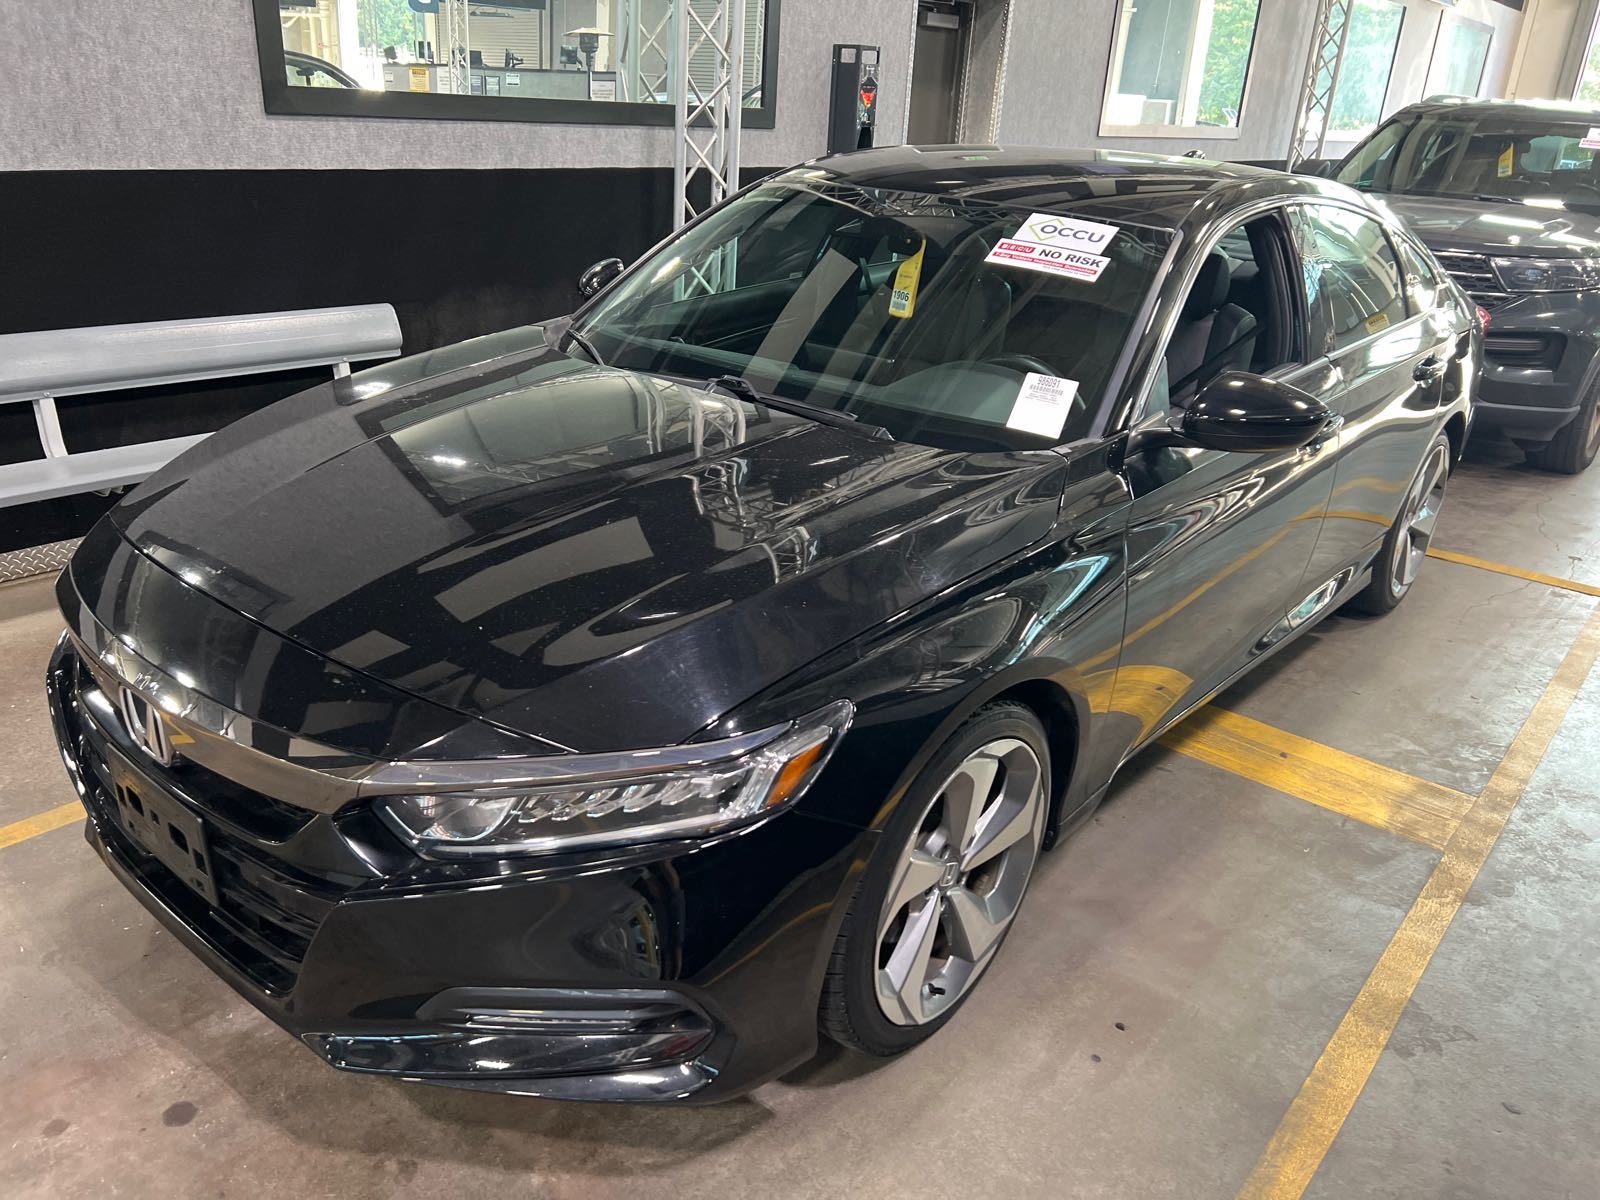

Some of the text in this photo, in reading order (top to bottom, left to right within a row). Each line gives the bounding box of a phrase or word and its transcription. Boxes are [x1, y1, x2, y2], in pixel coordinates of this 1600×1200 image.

[1040, 224, 1105, 243] OCCU
[1039, 249, 1062, 259] NO
[1065, 254, 1103, 268] RISK
[893, 290, 910, 302] 1906
